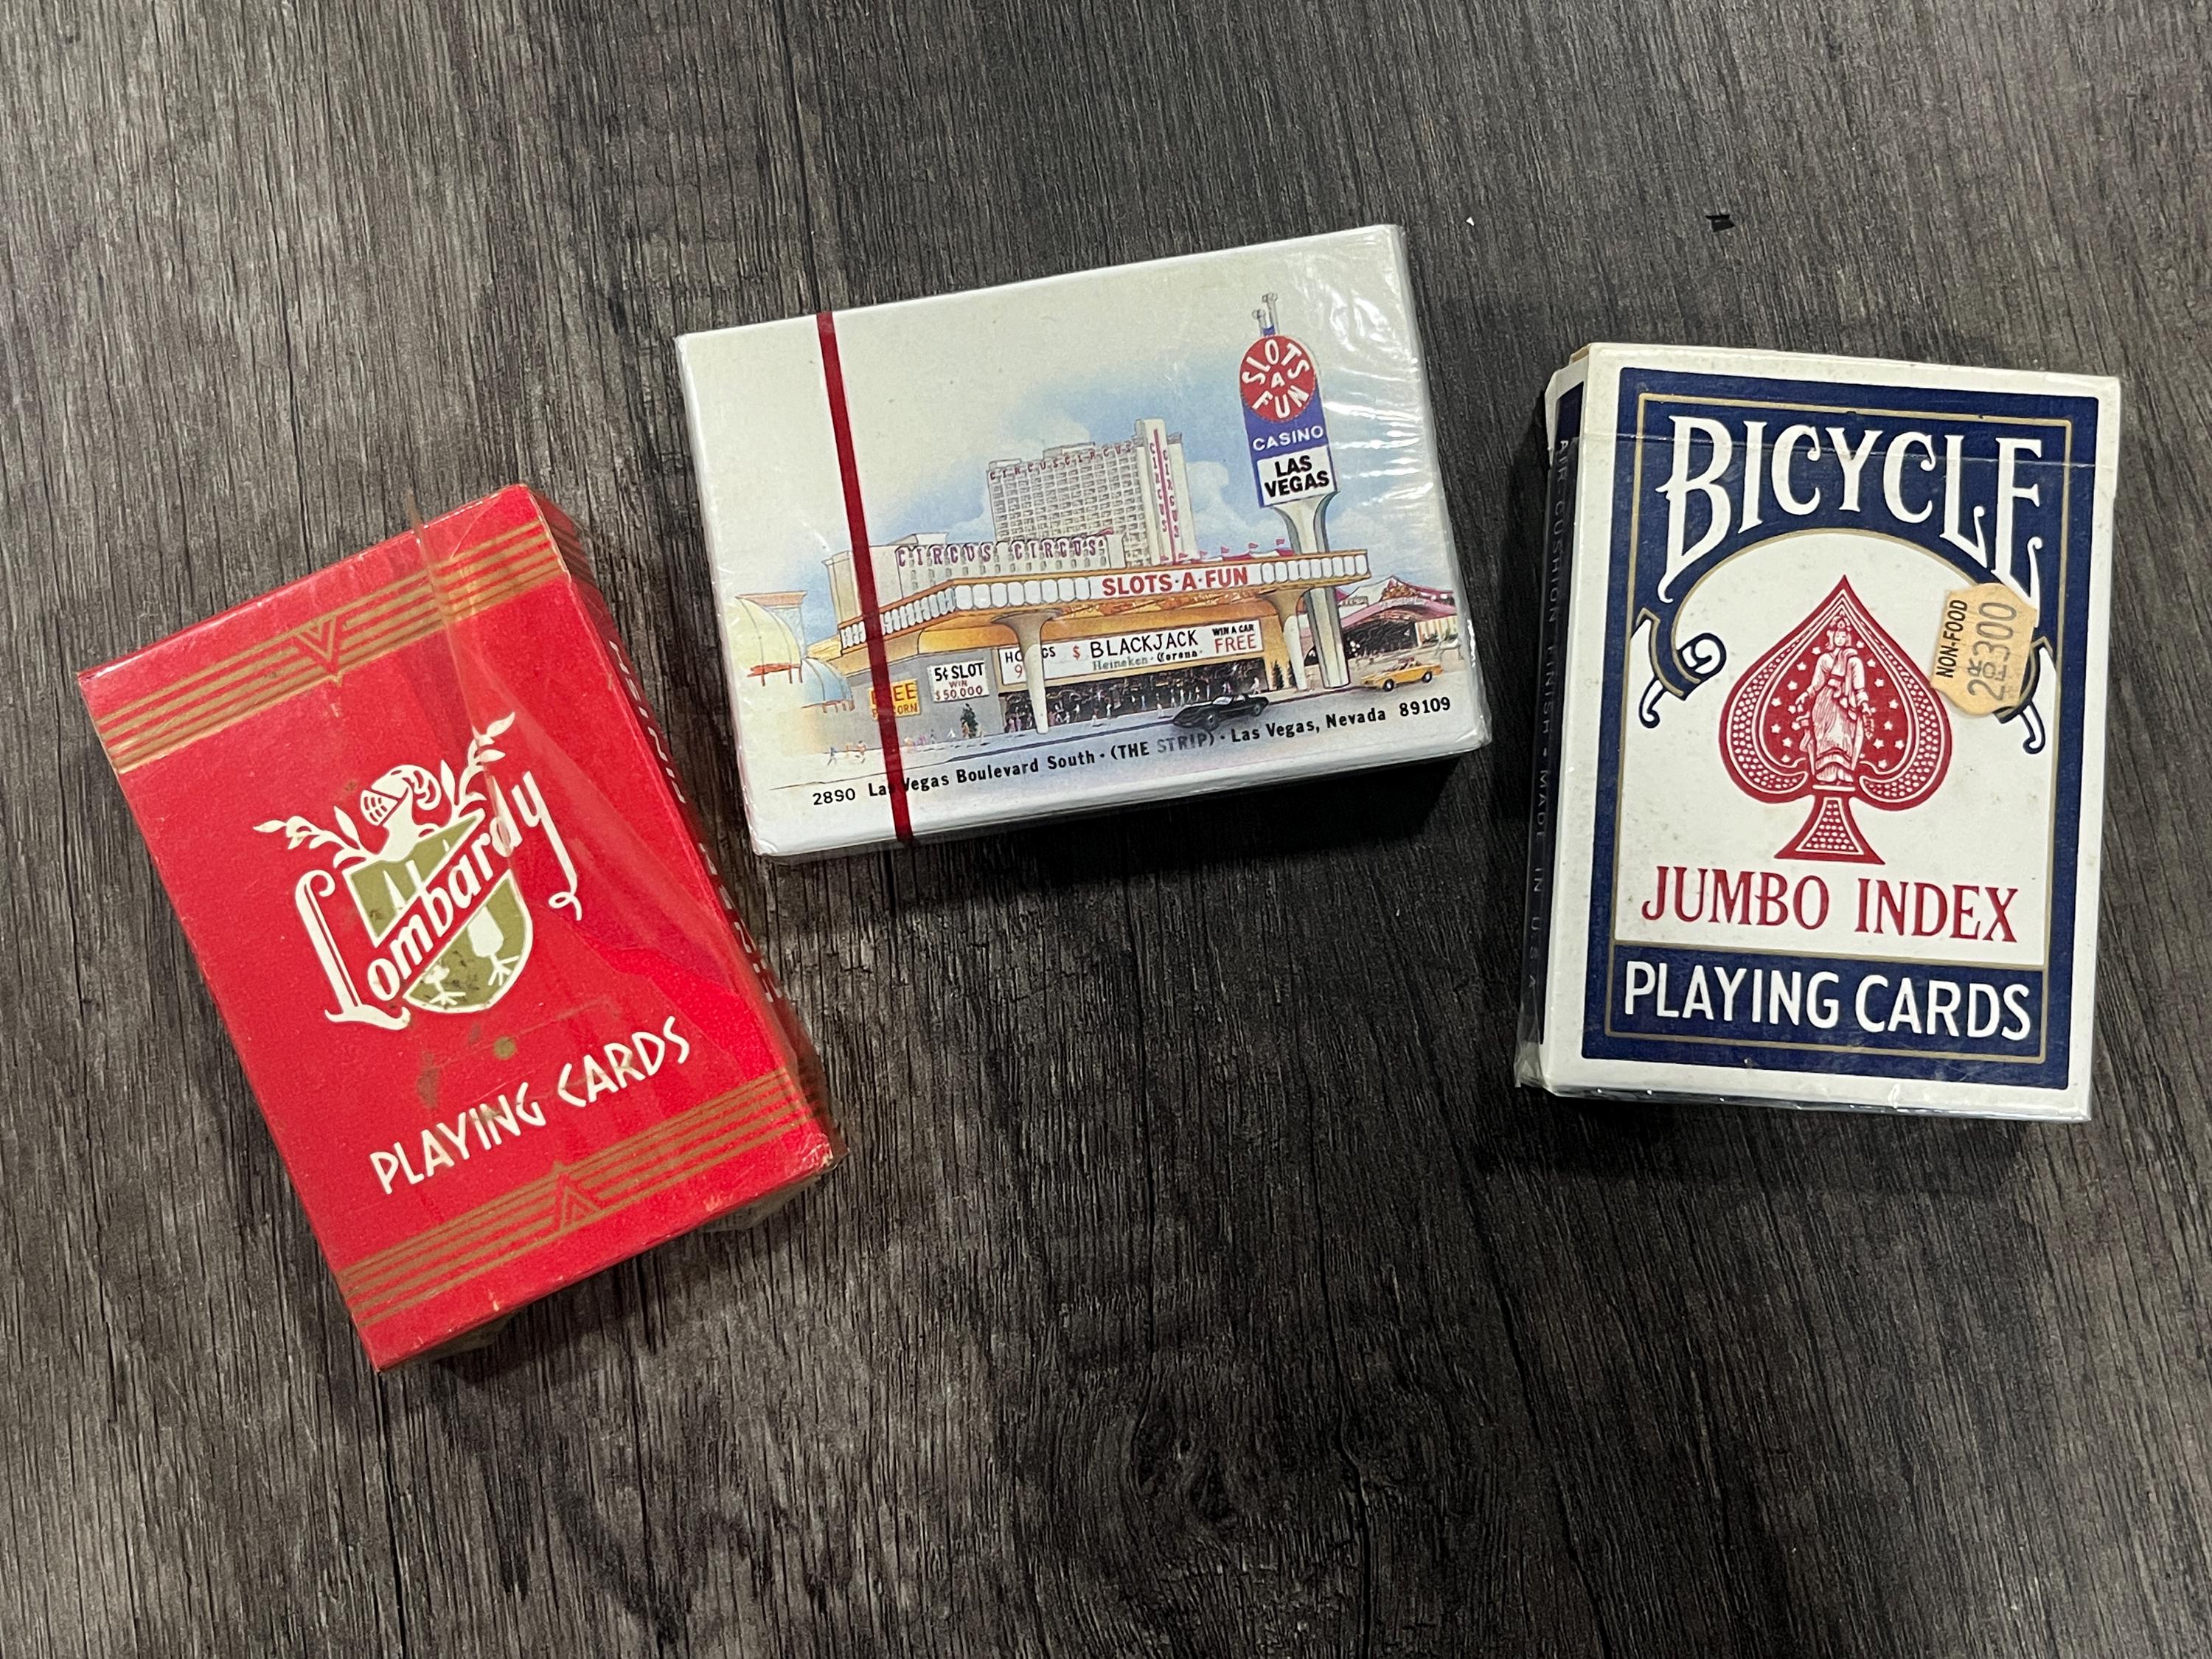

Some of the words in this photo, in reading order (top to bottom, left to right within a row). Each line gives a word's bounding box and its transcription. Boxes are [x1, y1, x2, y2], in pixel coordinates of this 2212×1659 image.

[1242, 339, 1310, 385] SLOTS
[1270, 372, 1285, 389] A
[1252, 385, 1310, 419] FUN
[1253, 425, 1324, 451] CASINO
[1275, 455, 1312, 477] LAS
[1265, 470, 1329, 498] VEGAS
[1655, 415, 2042, 627] BICYCLE
[897, 545, 991, 567] CIRCUS
[1014, 539, 1096, 560] CIRCUS
[1090, 630, 1198, 658] BLACKJACK
[1212, 627, 1229, 636] WIN
[1239, 624, 1254, 633] CAR
[1214, 633, 1256, 654] FREE
[1935, 599, 1968, 678] NON-FOOD
[951, 662, 984, 679] SLOT
[1093, 655, 1148, 671] Heineken
[1157, 650, 1198, 663] Corona
[871, 683, 917, 705] EE
[948, 680, 968, 688] WIN
[813, 787, 856, 806] 2890
[957, 758, 1039, 784] Boulevard
[1048, 749, 1094, 770] South
[1110, 743, 1149, 760] (THE
[1157, 731, 1215, 754] STRIP)
[1231, 728, 1259, 743] Las
[1266, 720, 1321, 740] Vegas,
[1326, 708, 1386, 728] Nevada
[1399, 697, 1450, 717] 89109
[1534, 868, 1543, 893] IN
[295, 771, 582, 1032] Lombardy
[1642, 866, 1829, 931] JUMBO
[1855, 878, 2018, 943] INDEX
[1625, 961, 1840, 1029] PLAYING
[1855, 974, 2031, 1040] CARDS
[369, 1082, 546, 1194] PLAYING
[557, 1016, 690, 1107] CARDS
